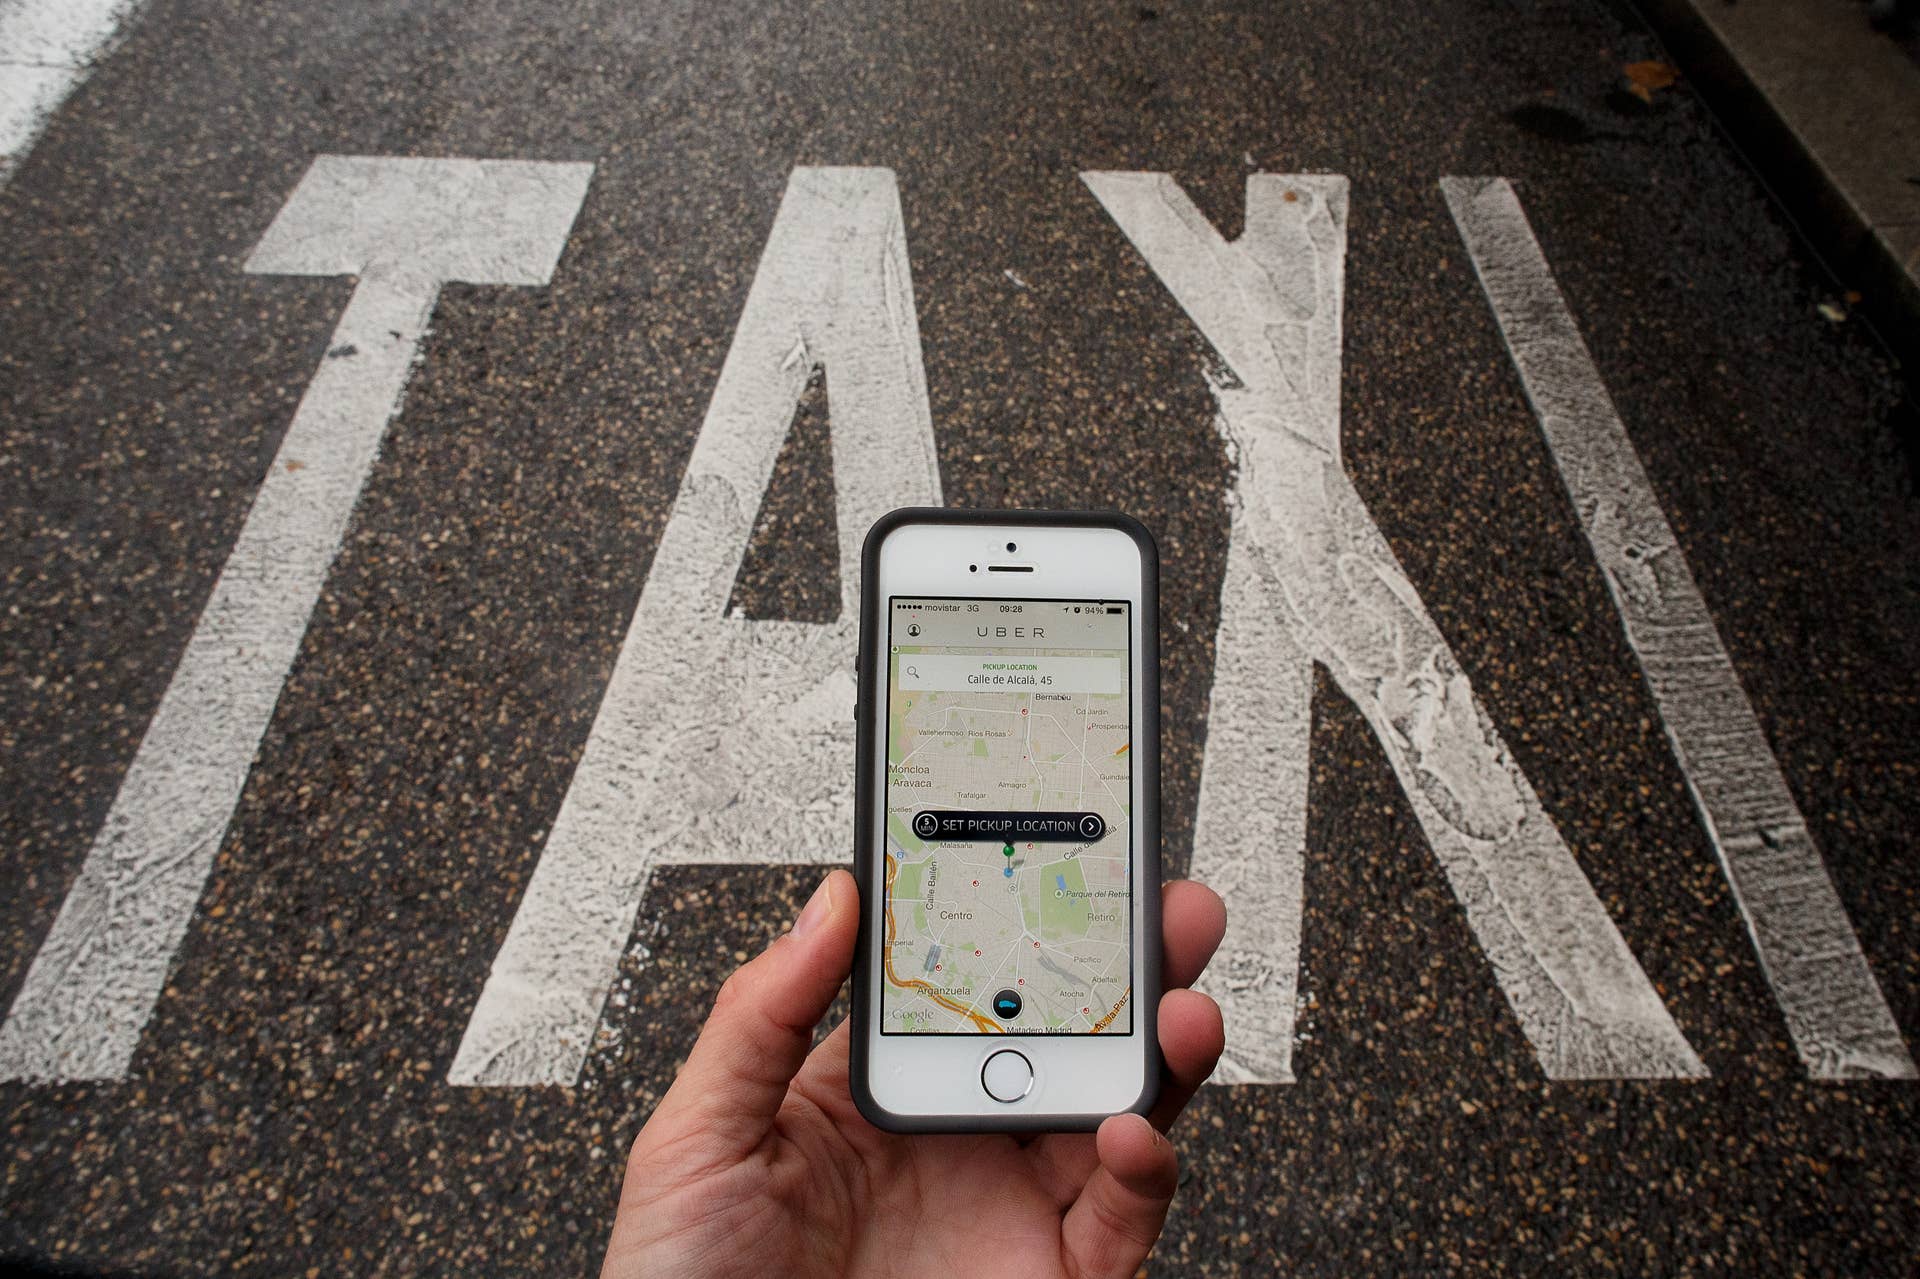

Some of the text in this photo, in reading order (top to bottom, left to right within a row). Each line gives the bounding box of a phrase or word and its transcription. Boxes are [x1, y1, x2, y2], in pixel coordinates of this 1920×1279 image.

[924, 604, 1104, 614] movistar 3G 09:28 94%
[0, 153, 1917, 1088] TAXI
[977, 626, 1046, 638] UBER
[982, 663, 1006, 671] PICKUP
[967, 674, 1053, 686] Calle de Alcalá, 45
[889, 765, 930, 774] Moncloa
[893, 779, 932, 788] Aravaca
[957, 791, 987, 800] Trafalgar
[924, 817, 930, 825] 5
[942, 819, 1076, 832] SET PICKUP LOCATION
[1066, 890, 1092, 899] Parque
[1094, 890, 1107, 898] del
[925, 889, 935, 910] Calle
[940, 910, 973, 920] Centro
[1087, 912, 1116, 922] Retiro
[916, 986, 971, 995] Arganzuela
[1059, 990, 1085, 998] Atocha
[892, 1009, 935, 1023] Google
[1006, 1026, 1072, 1034] Matadero Madrid
